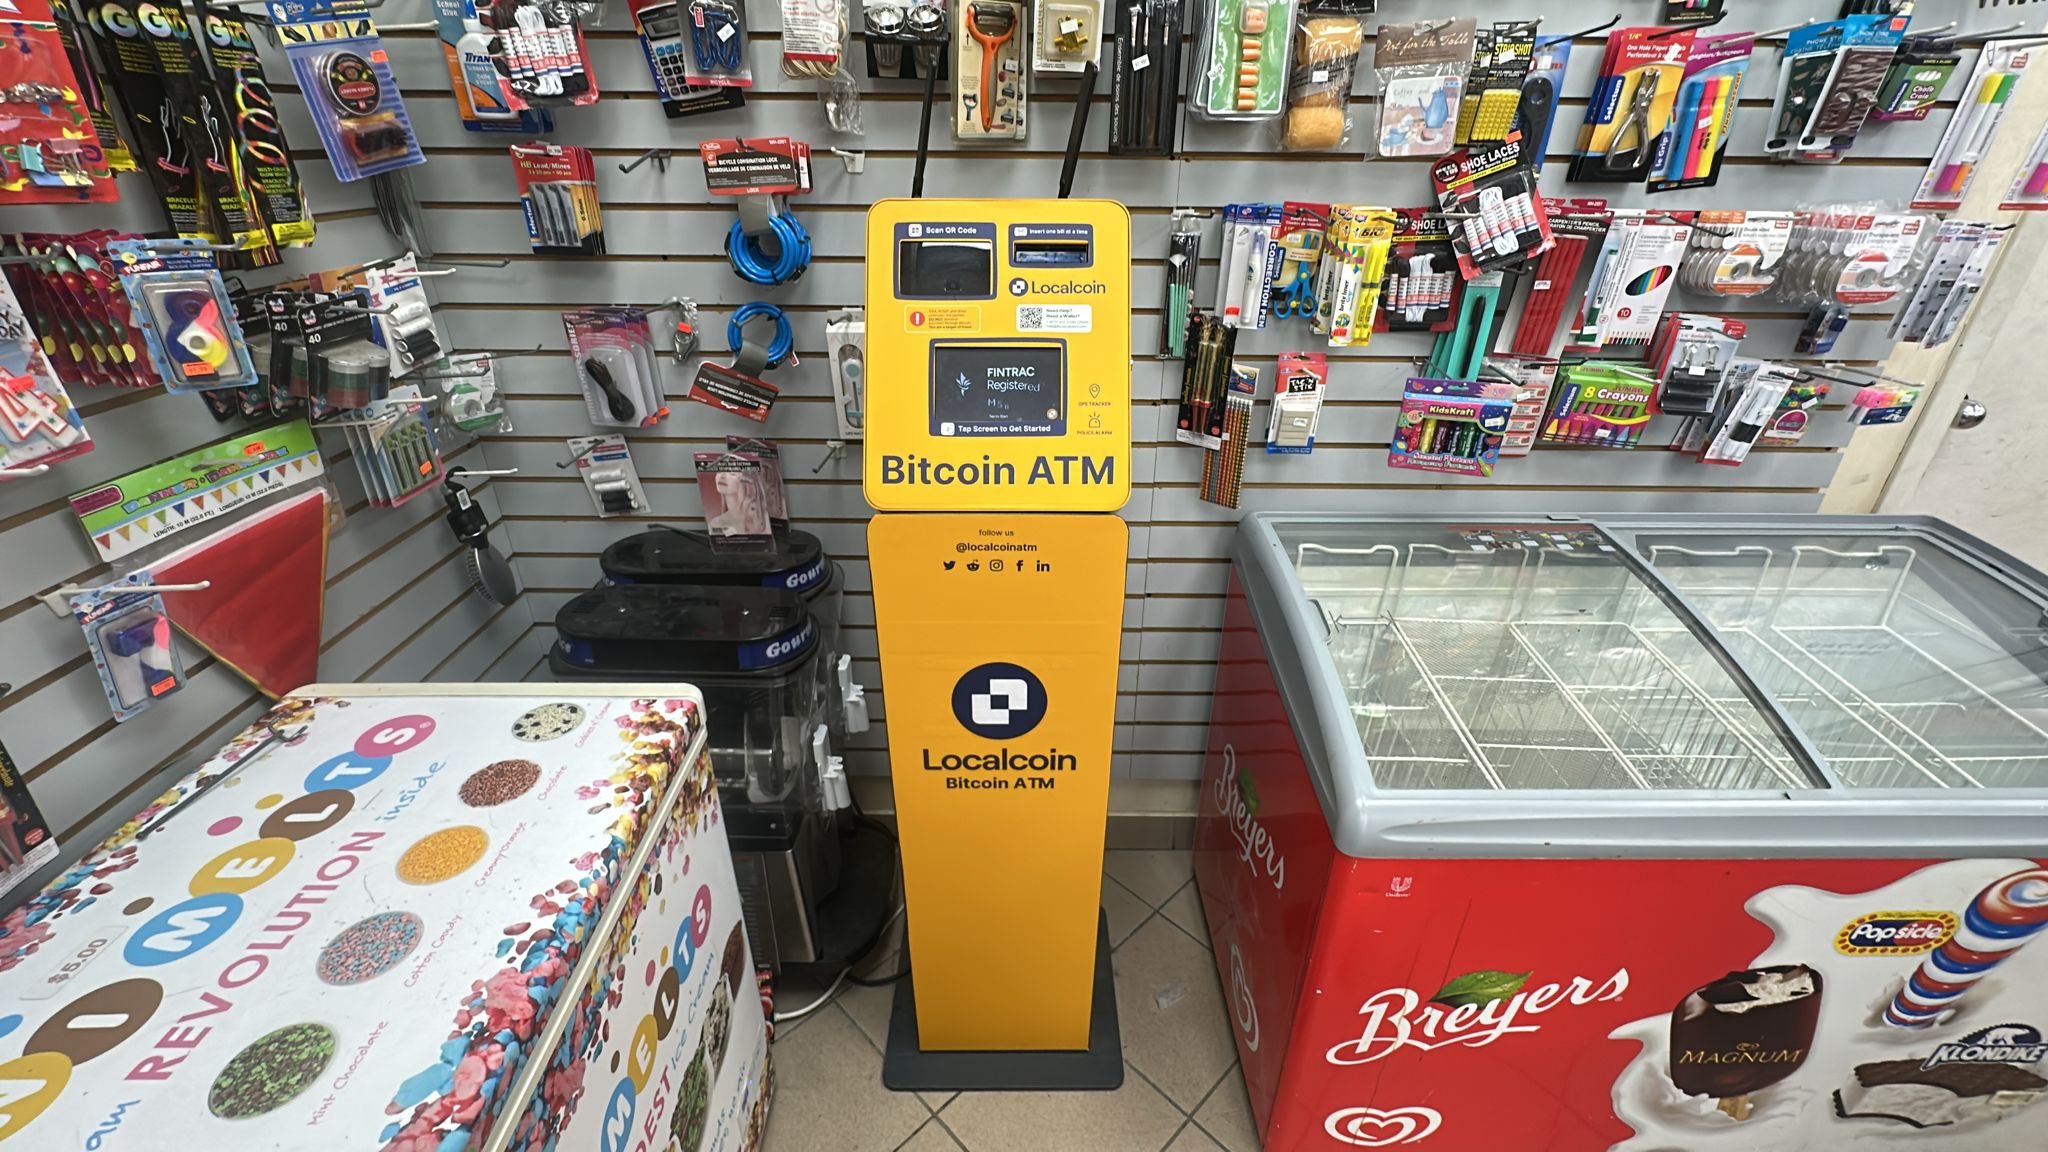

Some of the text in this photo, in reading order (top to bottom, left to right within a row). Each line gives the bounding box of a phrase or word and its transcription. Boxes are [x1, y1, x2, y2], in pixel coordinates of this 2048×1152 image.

[464, 52, 491, 64] TITAN
[1116, 37, 1124, 71] Ensemble
[1604, 78, 1623, 121] Selectum
[1112, 117, 1120, 143] sourcils
[1658, 136, 1669, 156] Grip
[1461, 154, 1487, 172] SHOE
[1488, 142, 1520, 161] LACES
[525, 200, 537, 236] Selectum
[1411, 219, 1437, 230] SHOE
[926, 227, 977, 235] Scan QR Code
[123, 259, 161, 274] FUNFAIR
[1032, 280, 1106, 295] Localcoin
[1258, 242, 1277, 329] CORRECTION PEN
[1620, 309, 1630, 317] 10
[274, 322, 288, 332] 40
[308, 333, 322, 345] 40
[987, 366, 1035, 378] FINTRAC
[987, 379, 1041, 393] Registered
[1583, 386, 1649, 402] 8 Crayons
[1559, 386, 1578, 416] Selectum
[1429, 405, 1475, 417] KidsKraft
[958, 424, 1051, 434] Tap Screen to Get Started
[882, 454, 1115, 485] Bitcoin ATM
[979, 529, 1003, 537] follow
[955, 542, 1038, 553] @localcoinatm
[923, 748, 1077, 771] Localcoin
[375, 761, 447, 823] inside
[946, 777, 1055, 789] Bitcoin ATM
[1850, 923, 1943, 943] Popsicle
[48, 937, 108, 986] $5.00
[125, 832, 387, 1081] REVOLUTION
[1325, 967, 1630, 1066] Breyers
[1679, 1047, 1804, 1065] MAGNUM
[1924, 1044, 2047, 1070] KLONDIKE
[307, 1018, 390, 1127] Mint Chocolate
